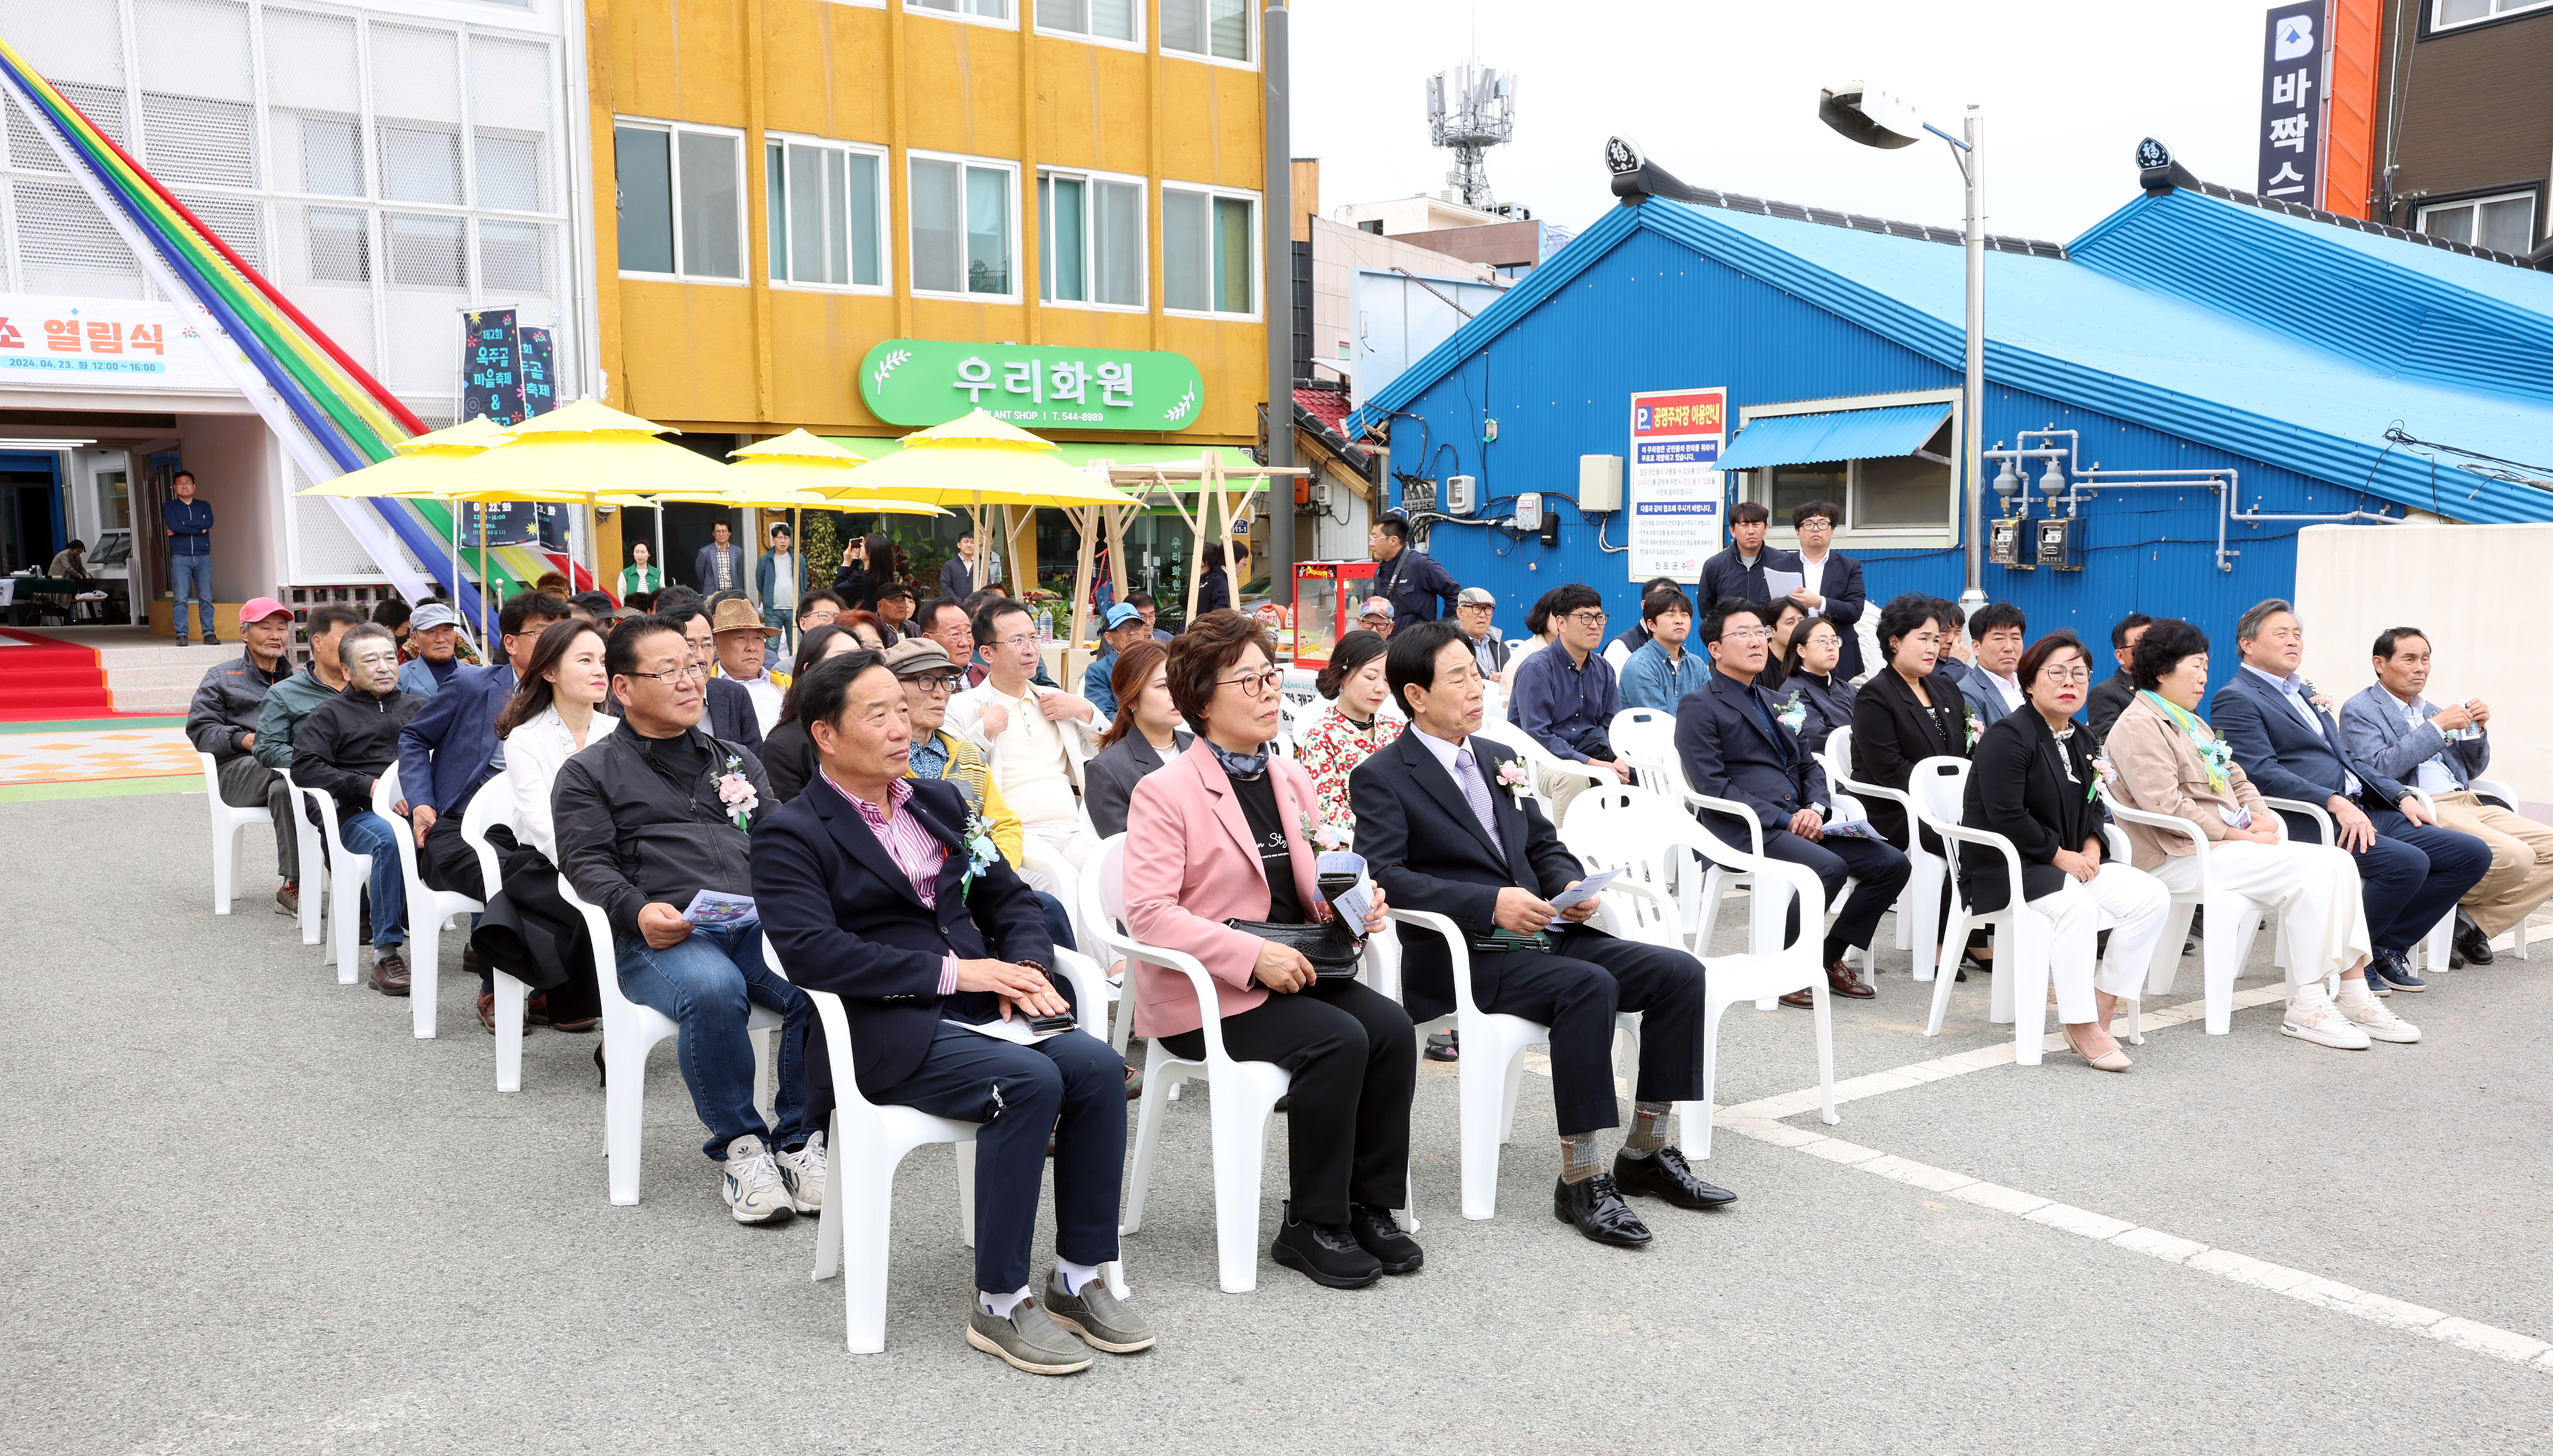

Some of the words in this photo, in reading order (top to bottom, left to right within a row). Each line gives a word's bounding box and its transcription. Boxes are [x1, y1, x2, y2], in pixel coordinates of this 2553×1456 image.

[2267, 67, 2312, 205] 바짝스
[43, 319, 164, 355] 열림식
[483, 328, 503, 340] 제2회
[476, 346, 509, 367] 옥주골
[10, 359, 38, 367] 2024.
[40, 360, 56, 369] 04.
[92, 362, 118, 370] 12:00
[130, 363, 156, 372] 16:00
[473, 369, 512, 388] 마을축제
[953, 356, 1134, 407] 우리화원
[491, 394, 500, 410] &
[983, 410, 1011, 421] PLANT
[1014, 411, 1038, 420] SHOP
[1052, 411, 1060, 421] T.
[1062, 411, 1103, 422] 544-8989
[1654, 405, 1690, 428] 공영주차장
[1691, 403, 1720, 426] 이용안내
[1647, 445, 1665, 454] 주차장은
[1701, 443, 1715, 452] 위하여
[473, 502, 487, 512] 0.
[488, 503, 500, 512] 23.
[502, 502, 512, 512] 화
[547, 505, 556, 516] 화
[1691, 504, 1712, 512] 바랍니다.
[1171, 537, 1181, 591] 우리화원
[1306, 565, 1328, 578] Popcorn
